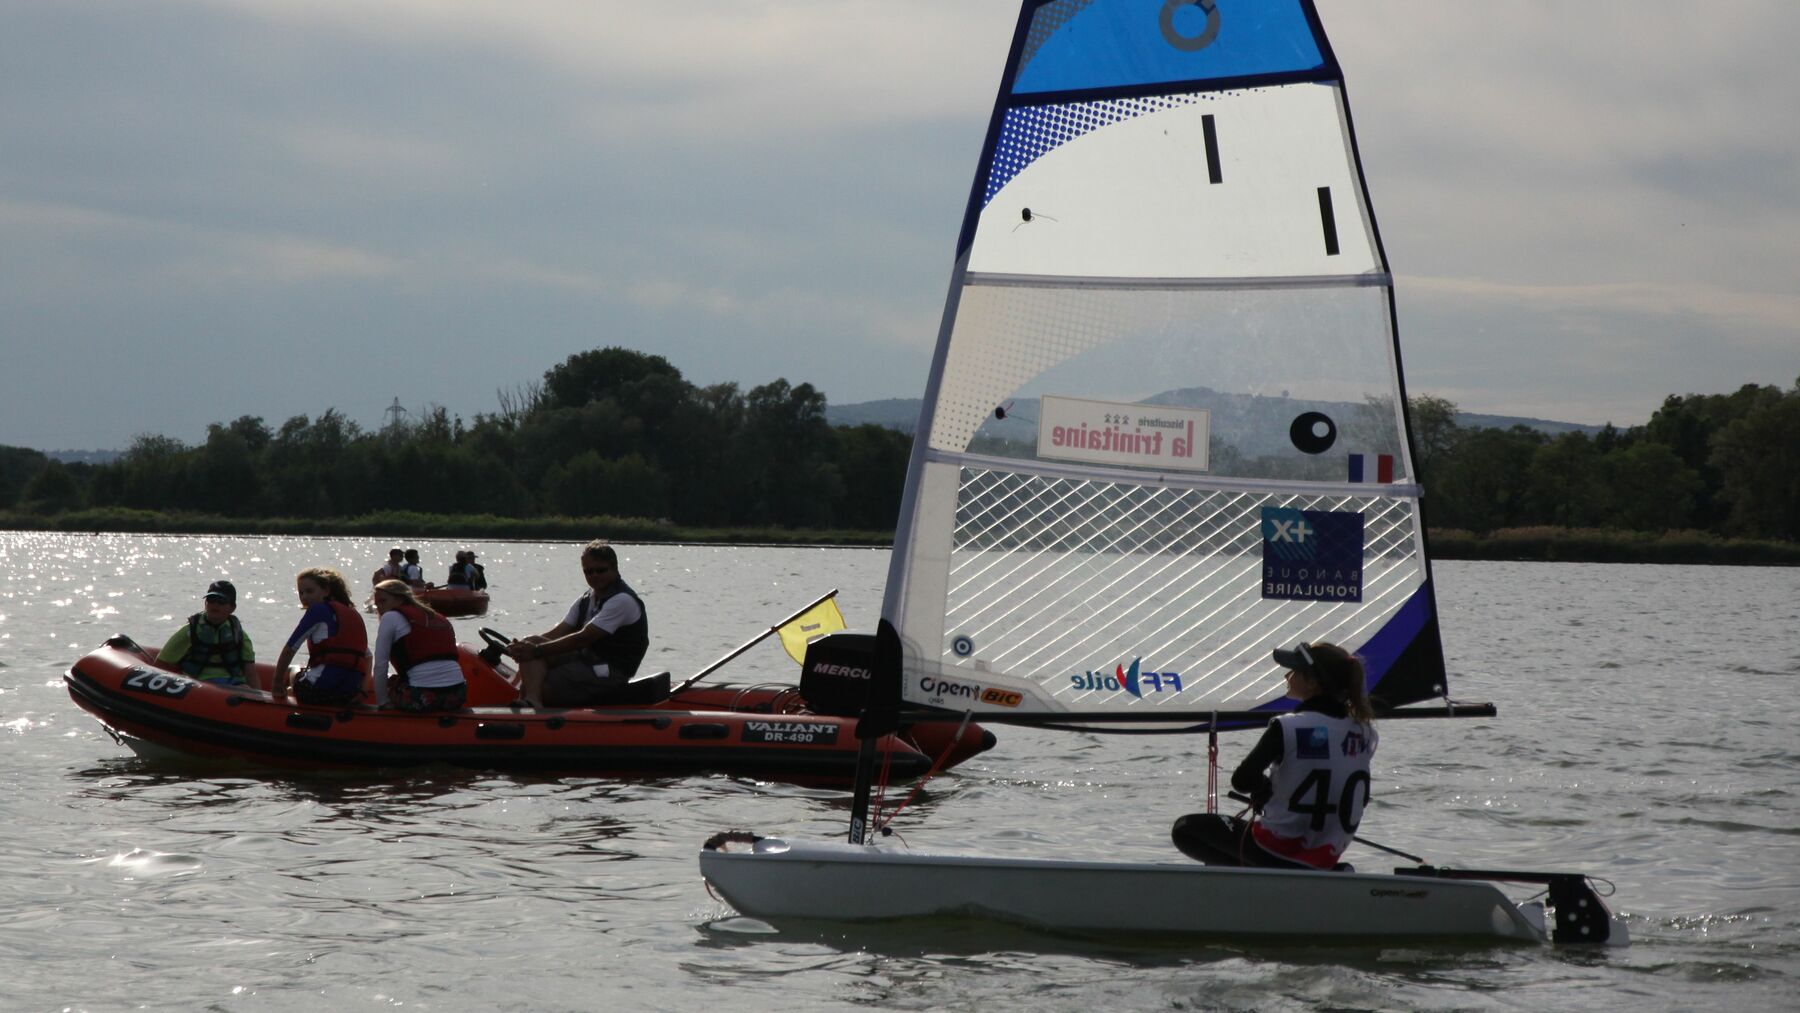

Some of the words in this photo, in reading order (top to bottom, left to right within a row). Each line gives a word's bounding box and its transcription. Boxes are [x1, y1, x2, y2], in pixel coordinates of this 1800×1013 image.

[813, 663, 872, 680] MERCU
[127, 666, 192, 694] 263
[985, 689, 1020, 705] BIC
[746, 721, 838, 734] VALIANT
[764, 732, 814, 742] DR-490
[1288, 768, 1371, 834] 40
